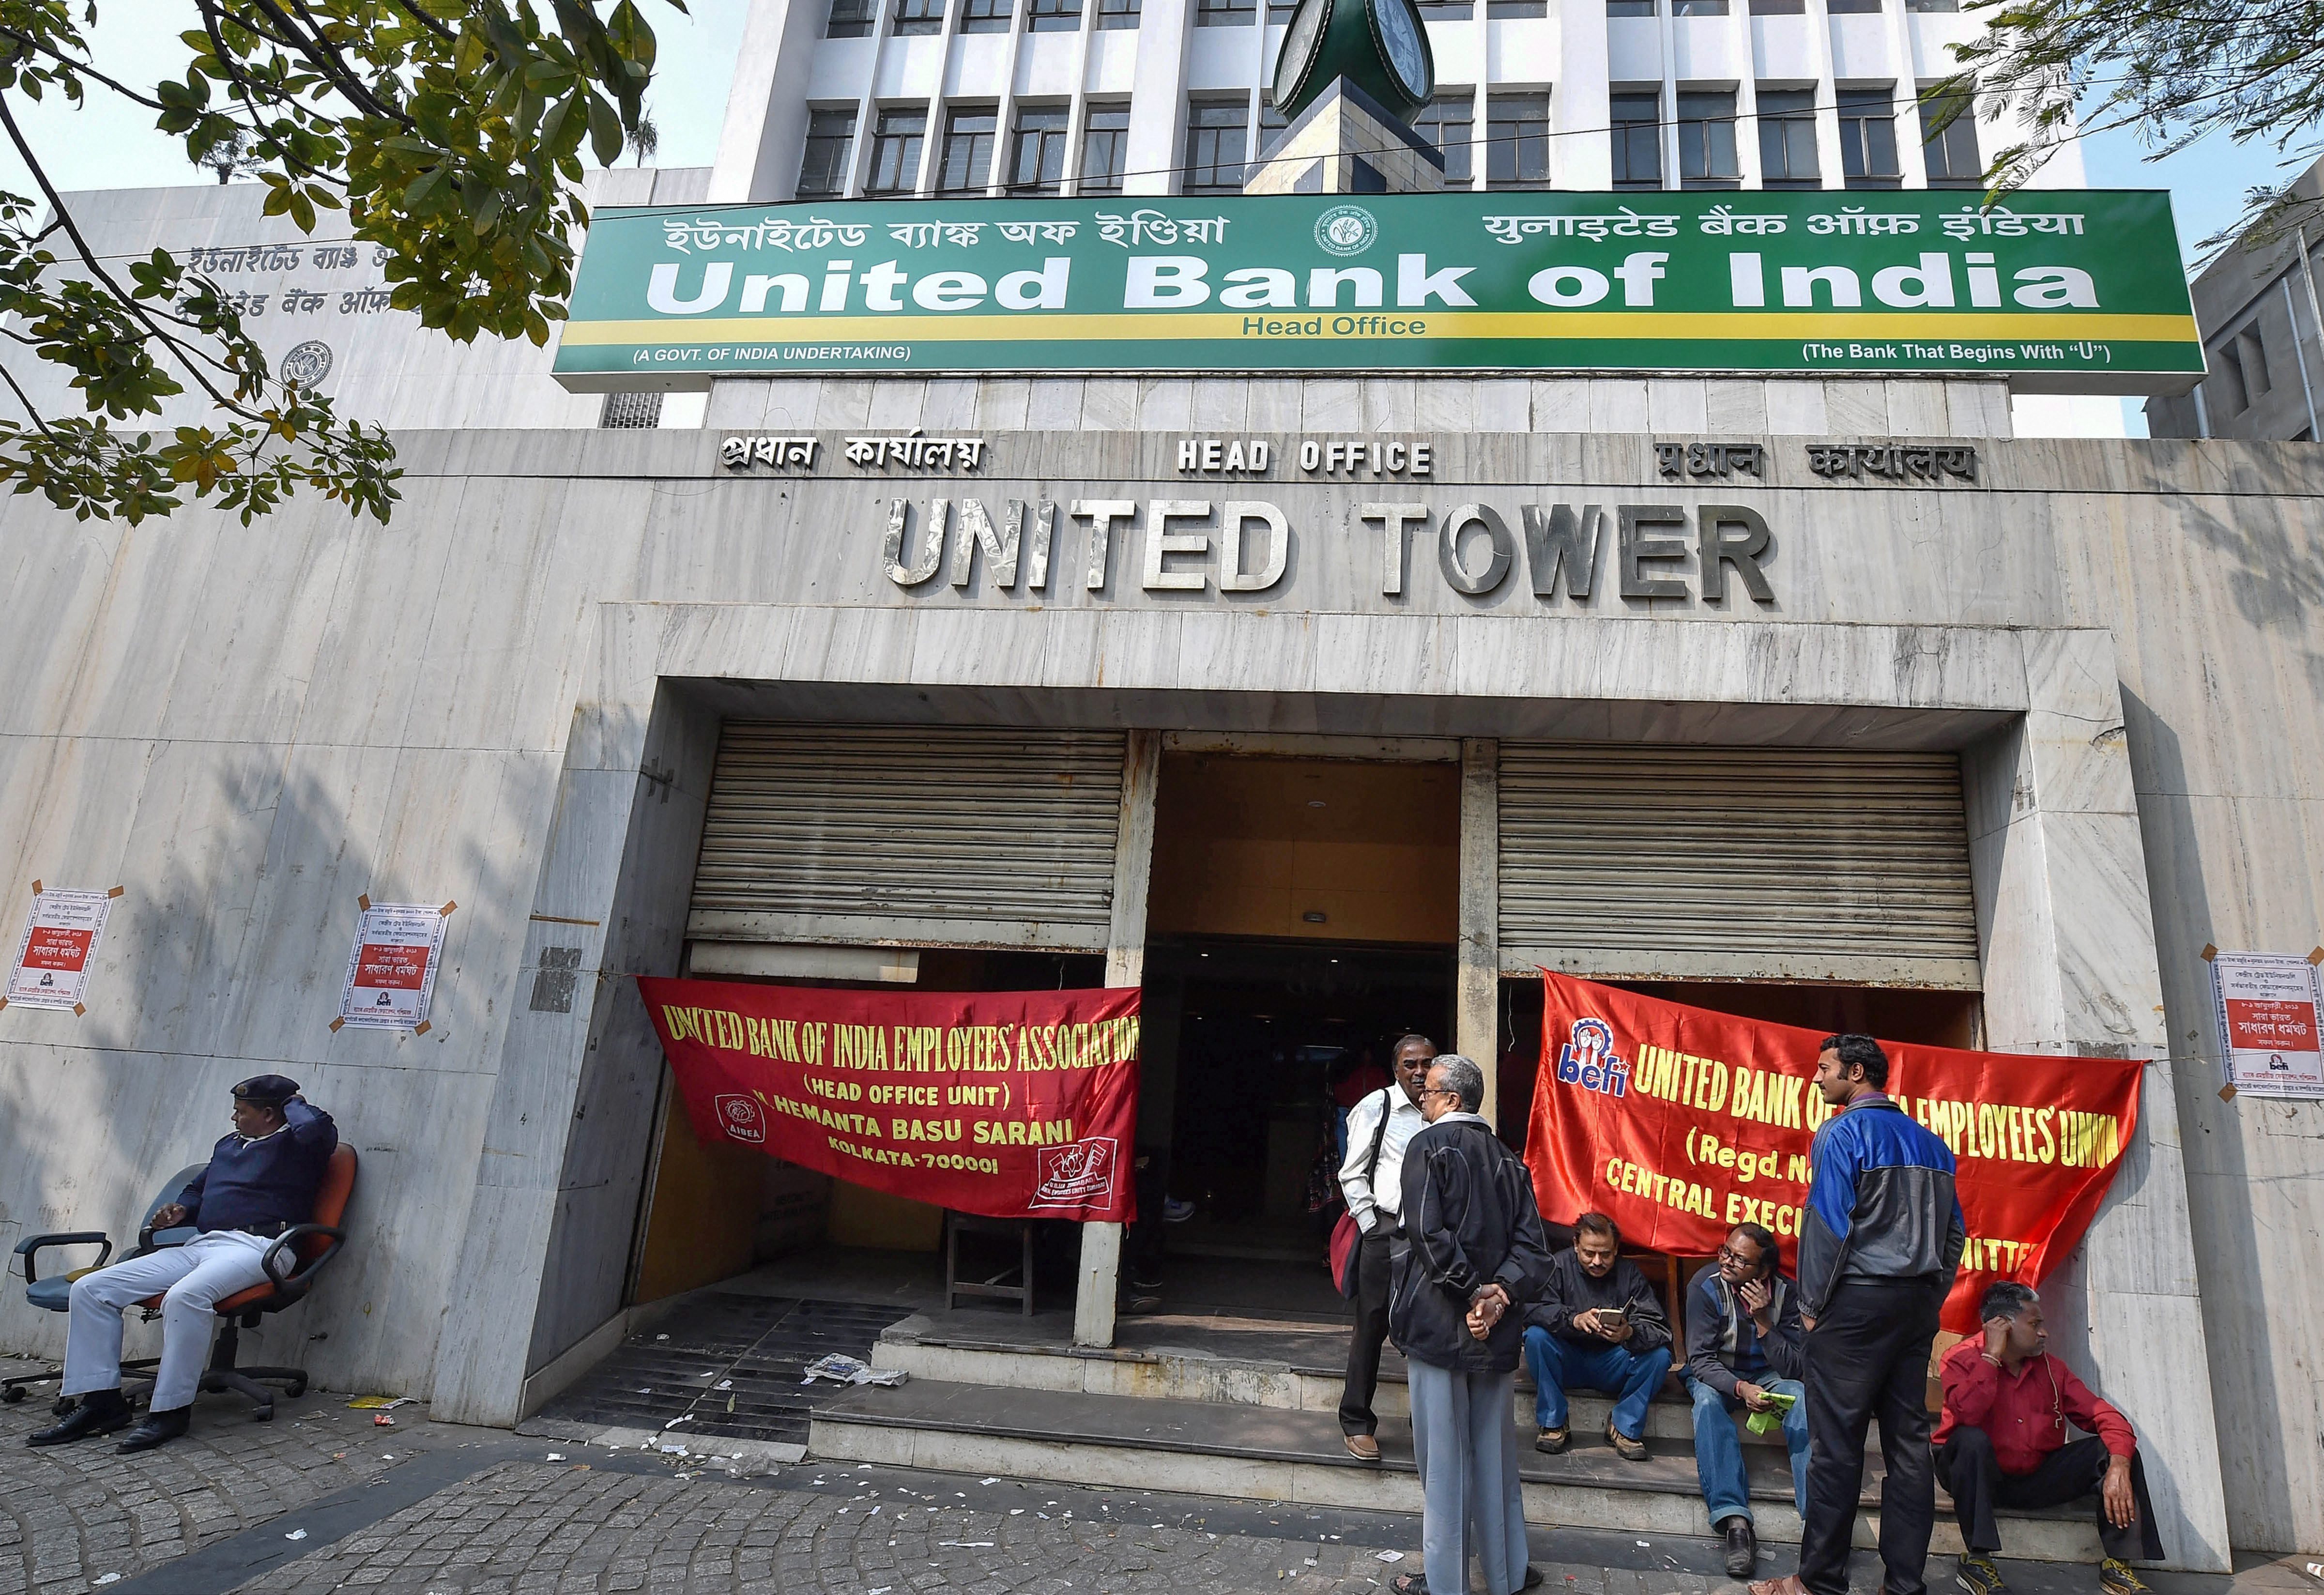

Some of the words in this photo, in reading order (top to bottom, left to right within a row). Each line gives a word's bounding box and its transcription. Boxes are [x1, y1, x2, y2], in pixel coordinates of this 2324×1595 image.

[663, 216, 872, 255] ইউনাইটেড
[994, 220, 1081, 246] অফ
[1096, 209, 1231, 248] ইণ্ডিয়া
[1482, 206, 1681, 243] युनाइटेड
[1698, 205, 1788, 235] बैंक
[1939, 206, 2084, 241] इंडिया
[645, 256, 1071, 315] United
[1122, 253, 1478, 311] Bank
[1528, 252, 1670, 307] of
[1729, 252, 2100, 308] India
[1241, 314, 1322, 337] Head
[1331, 314, 1426, 337] Office
[633, 346, 650, 364] (A
[655, 348, 702, 362] GOVT.
[708, 347, 729, 361] OF
[734, 346, 778, 360] INDIA
[782, 344, 911, 362] UNDERTAKING)
[1803, 343, 1843, 361] (The
[1849, 344, 1896, 359] Bank
[1902, 344, 1942, 359] That
[1947, 344, 2014, 363] Begins
[2019, 343, 2063, 359] With
[721, 436, 819, 465] প্রধান
[844, 426, 984, 468] কার্যালয়
[1178, 440, 1268, 470] HEAD
[1300, 441, 1431, 473] OFFICE
[1653, 443, 1763, 475] प्रधान
[882, 497, 1289, 592] UNITED
[1361, 502, 1775, 603] TOWER
[661, 1004, 744, 1050] UNITED
[746, 1016, 800, 1064] BANK
[802, 1020, 826, 1065] OF
[832, 1023, 888, 1071] INDIA
[1016, 1015, 1141, 1072] ASSOCIATION
[2238, 1021, 2275, 1035] সাধারণ
[2278, 1019, 2307, 1036] ধর্মঘট
[1559, 1044, 1626, 1097] befi
[803, 1073, 861, 1102] (HEAD
[870, 1085, 939, 1106] OFFICE
[947, 1081, 1010, 1111] UNIT)
[1634, 1043, 1730, 1113] UNITED
[1730, 1068, 1804, 1131] BANK
[2059, 1110, 2120, 1169] UNION
[730, 1124, 760, 1138] AIBEA
[774, 1094, 880, 1137] HEMANTA
[892, 1118, 963, 1142] BASU
[973, 1118, 1072, 1146] SARANI
[1686, 1126, 1783, 1183] (Regd.
[1605, 1157, 1717, 1220] CENTRAL
